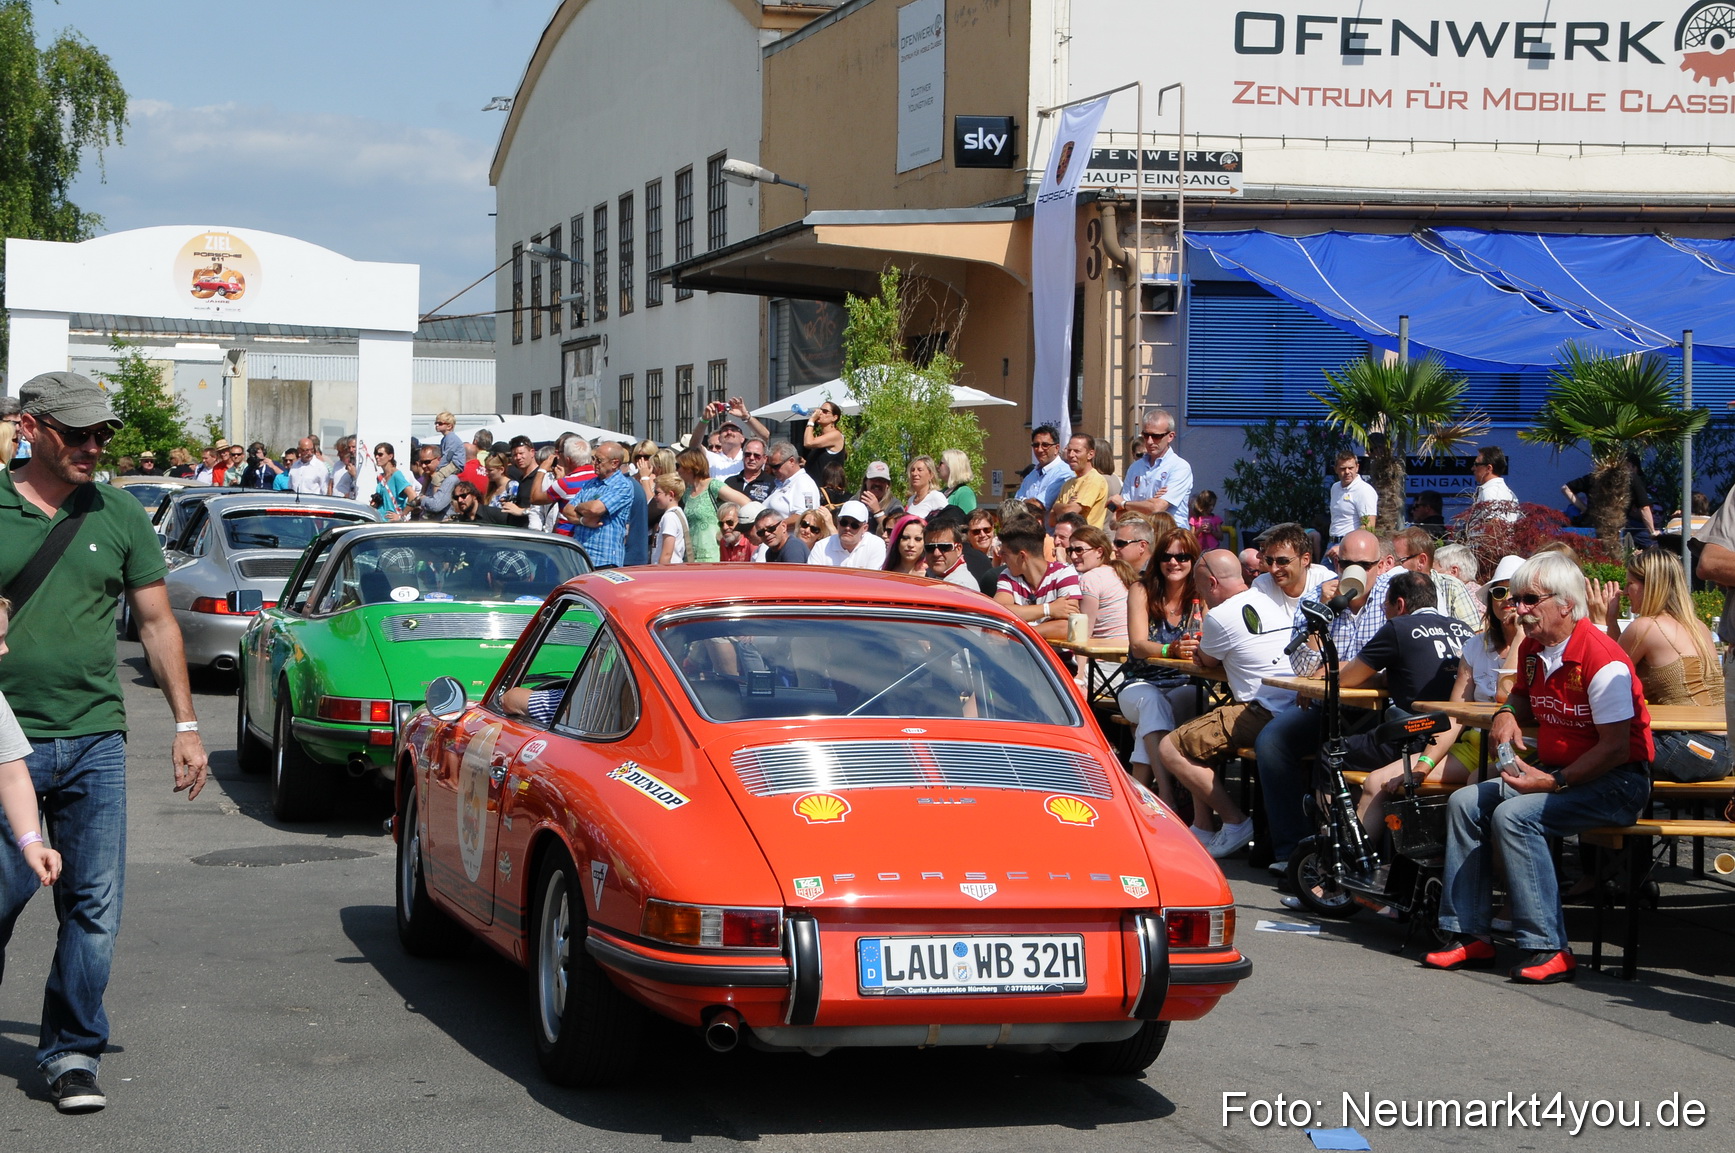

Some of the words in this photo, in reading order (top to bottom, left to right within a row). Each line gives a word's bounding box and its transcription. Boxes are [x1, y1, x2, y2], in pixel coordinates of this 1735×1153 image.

[1234, 11, 1666, 64] OFENWERK
[1232, 81, 1392, 108] ZENTRUM
[1406, 82, 1468, 110] FÜR
[1483, 88, 1606, 112] MOBILE
[964, 127, 1008, 156] sky
[1092, 150, 1217, 163] FENWERK
[204, 236, 232, 250] ZIEL
[1086, 218, 1101, 281] 3
[193, 251, 242, 259] PORSCHE
[398, 590, 411, 598] 61
[625, 771, 684, 805] DUNLOP
[832, 871, 1112, 883] PORSCHE
[962, 884, 997, 899] HEUER
[884, 943, 949, 981] LAU
[973, 942, 1015, 979] WB
[1021, 942, 1081, 978] 32H
[867, 968, 876, 979] D
[967, 984, 998, 994] Nürnberg
